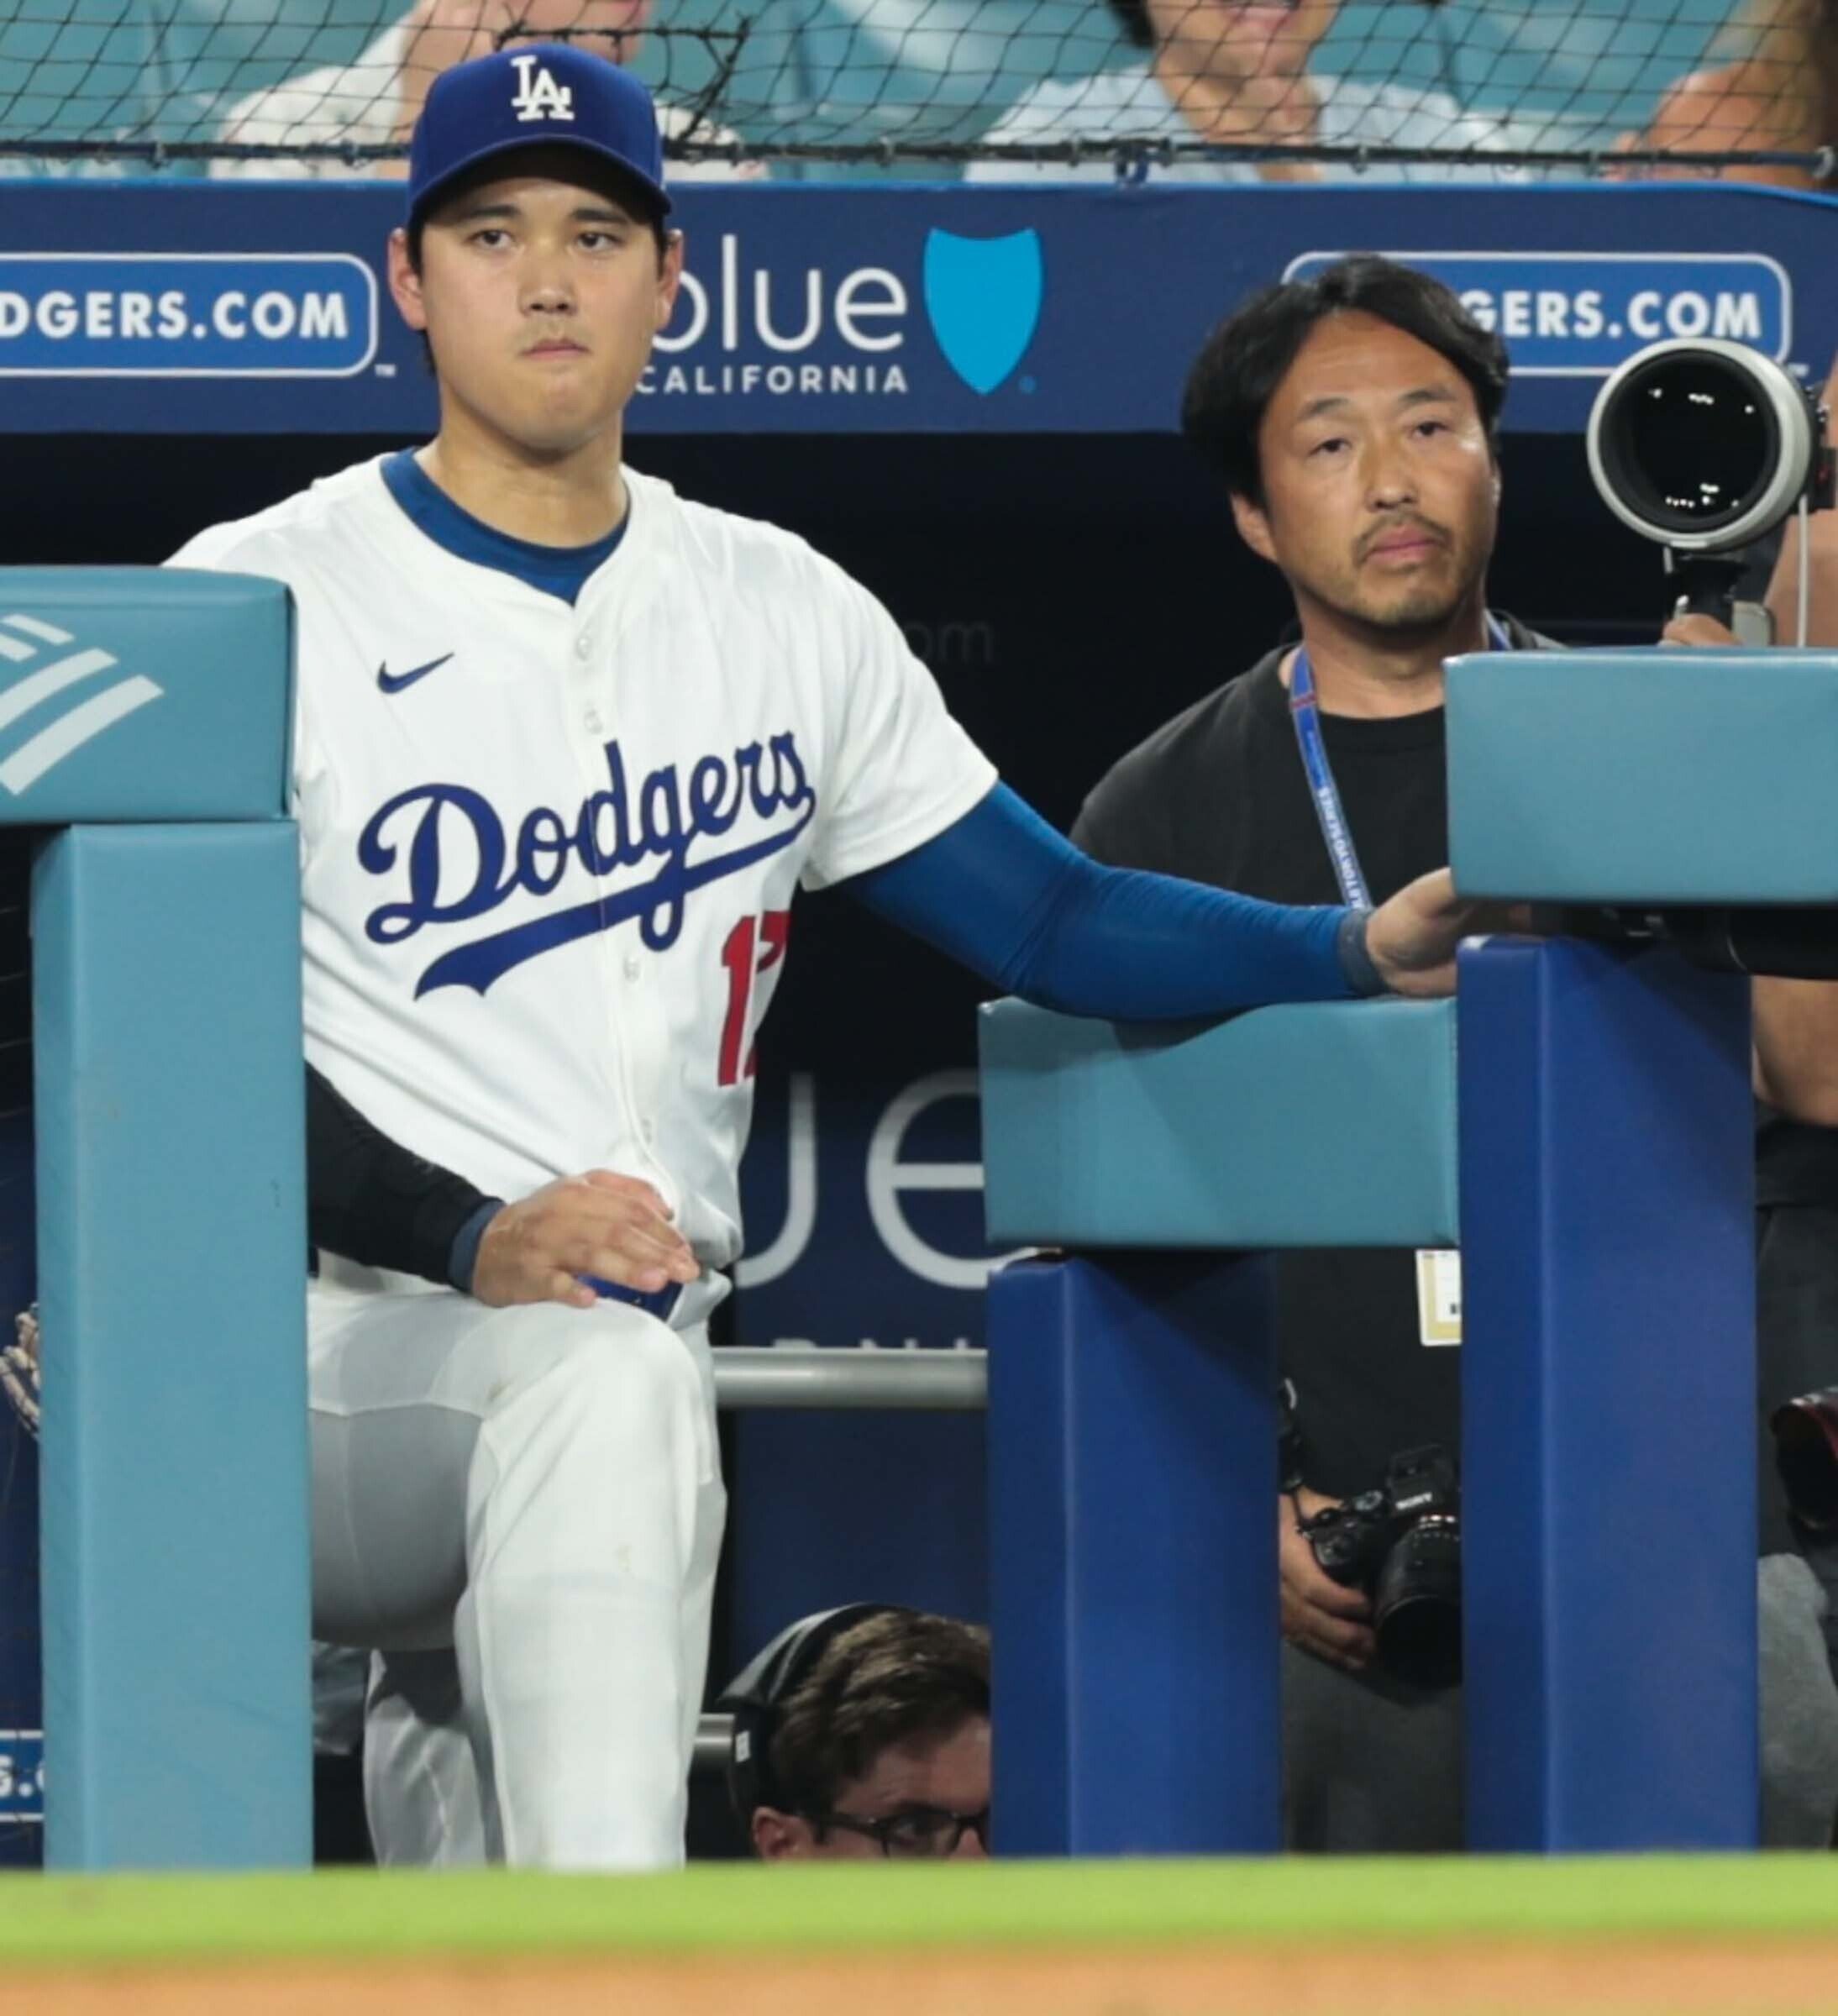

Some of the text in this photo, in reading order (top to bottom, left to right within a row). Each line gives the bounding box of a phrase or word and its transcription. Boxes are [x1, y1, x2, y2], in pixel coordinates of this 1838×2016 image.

[510, 55, 575, 122] LA
[0, 291, 349, 339] DGERS.COM
[635, 365, 908, 394] CALIFORNIA
[358, 730, 816, 1001] Dodgers
